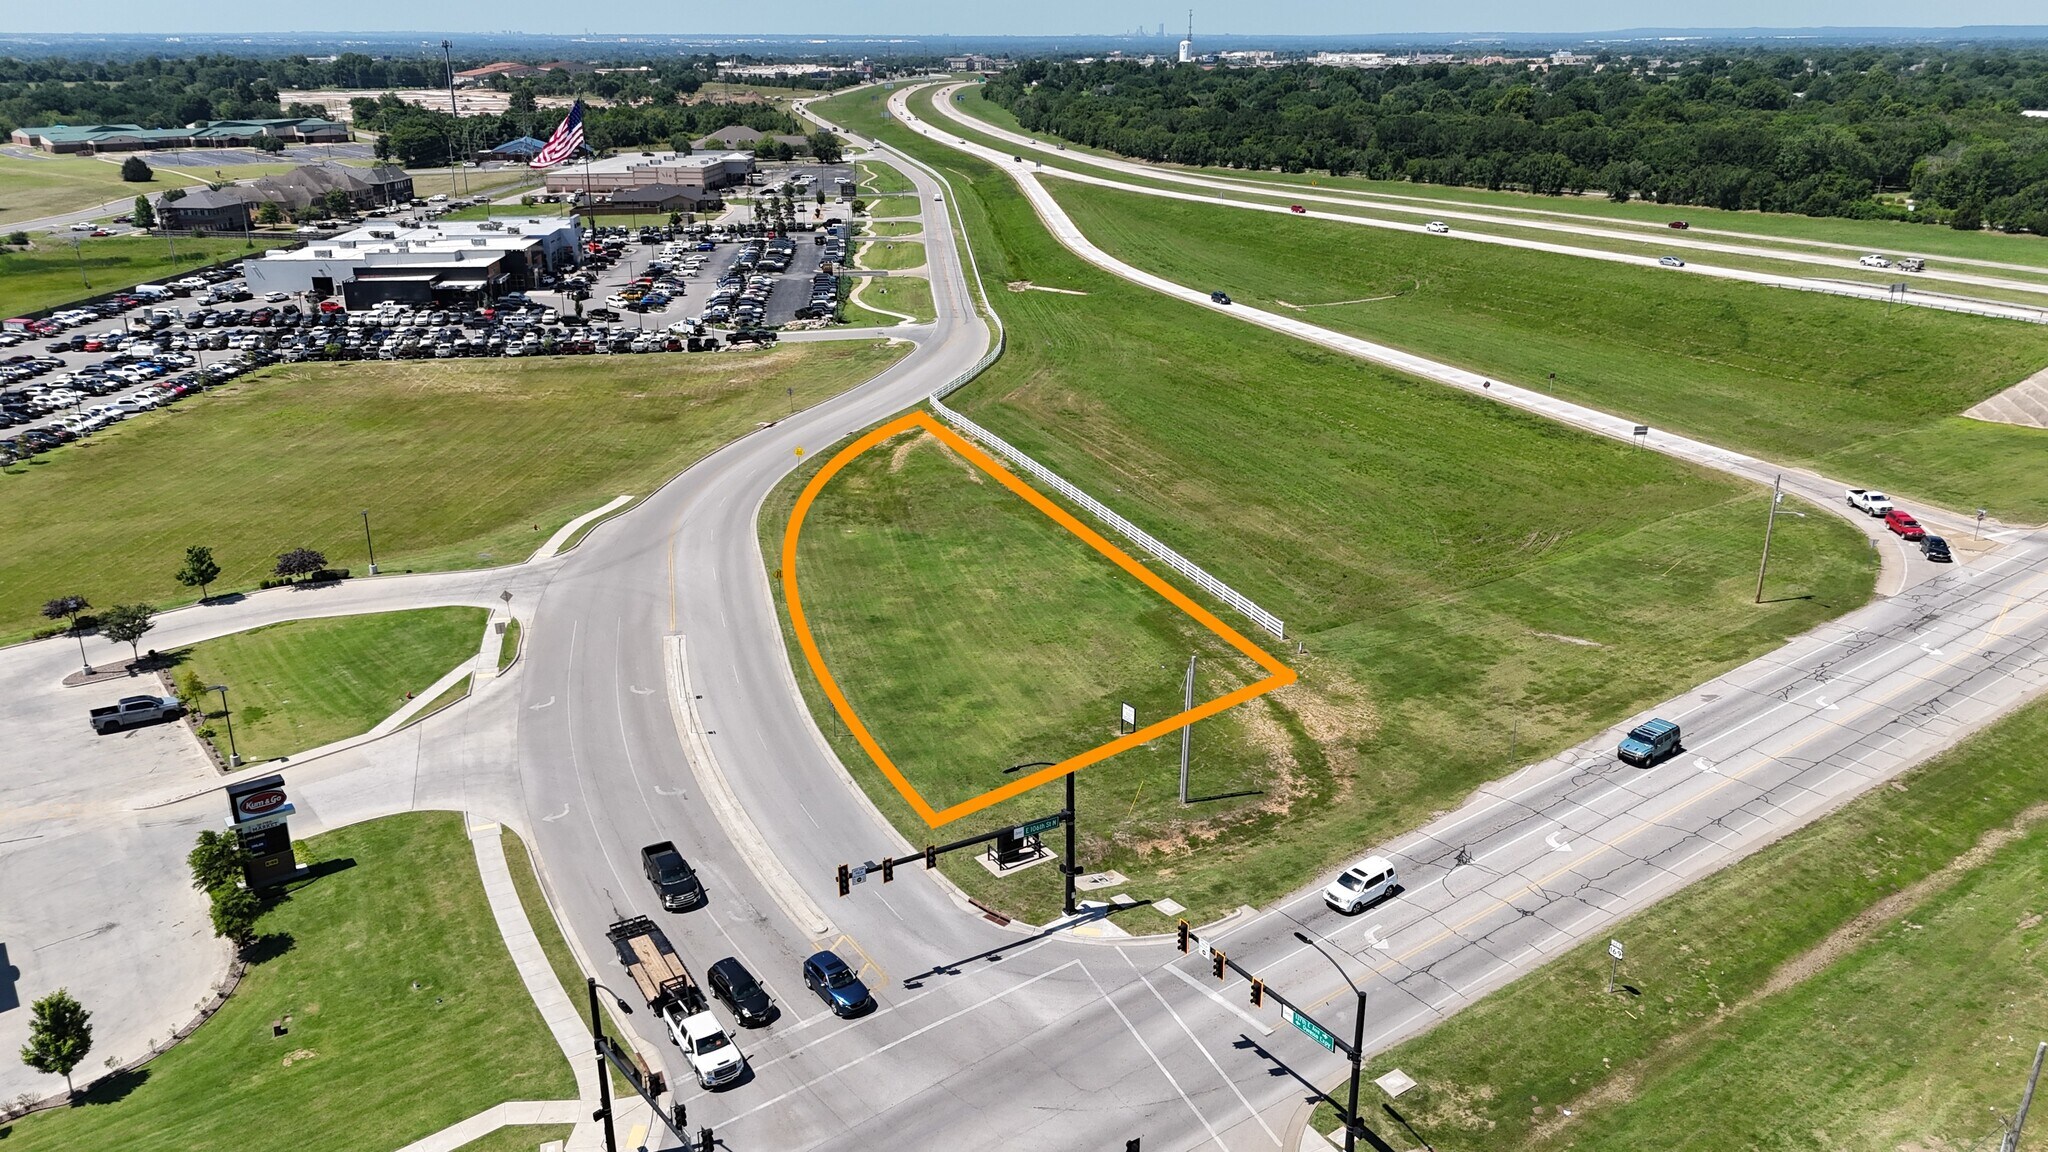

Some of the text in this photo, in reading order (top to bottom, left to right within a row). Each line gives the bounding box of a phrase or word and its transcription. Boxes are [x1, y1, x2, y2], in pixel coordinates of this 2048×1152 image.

[246, 800, 264, 810] Kum
[270, 794, 282, 804] Go
[1030, 823, 1045, 832] 106th
[1610, 946, 1622, 957] 169
